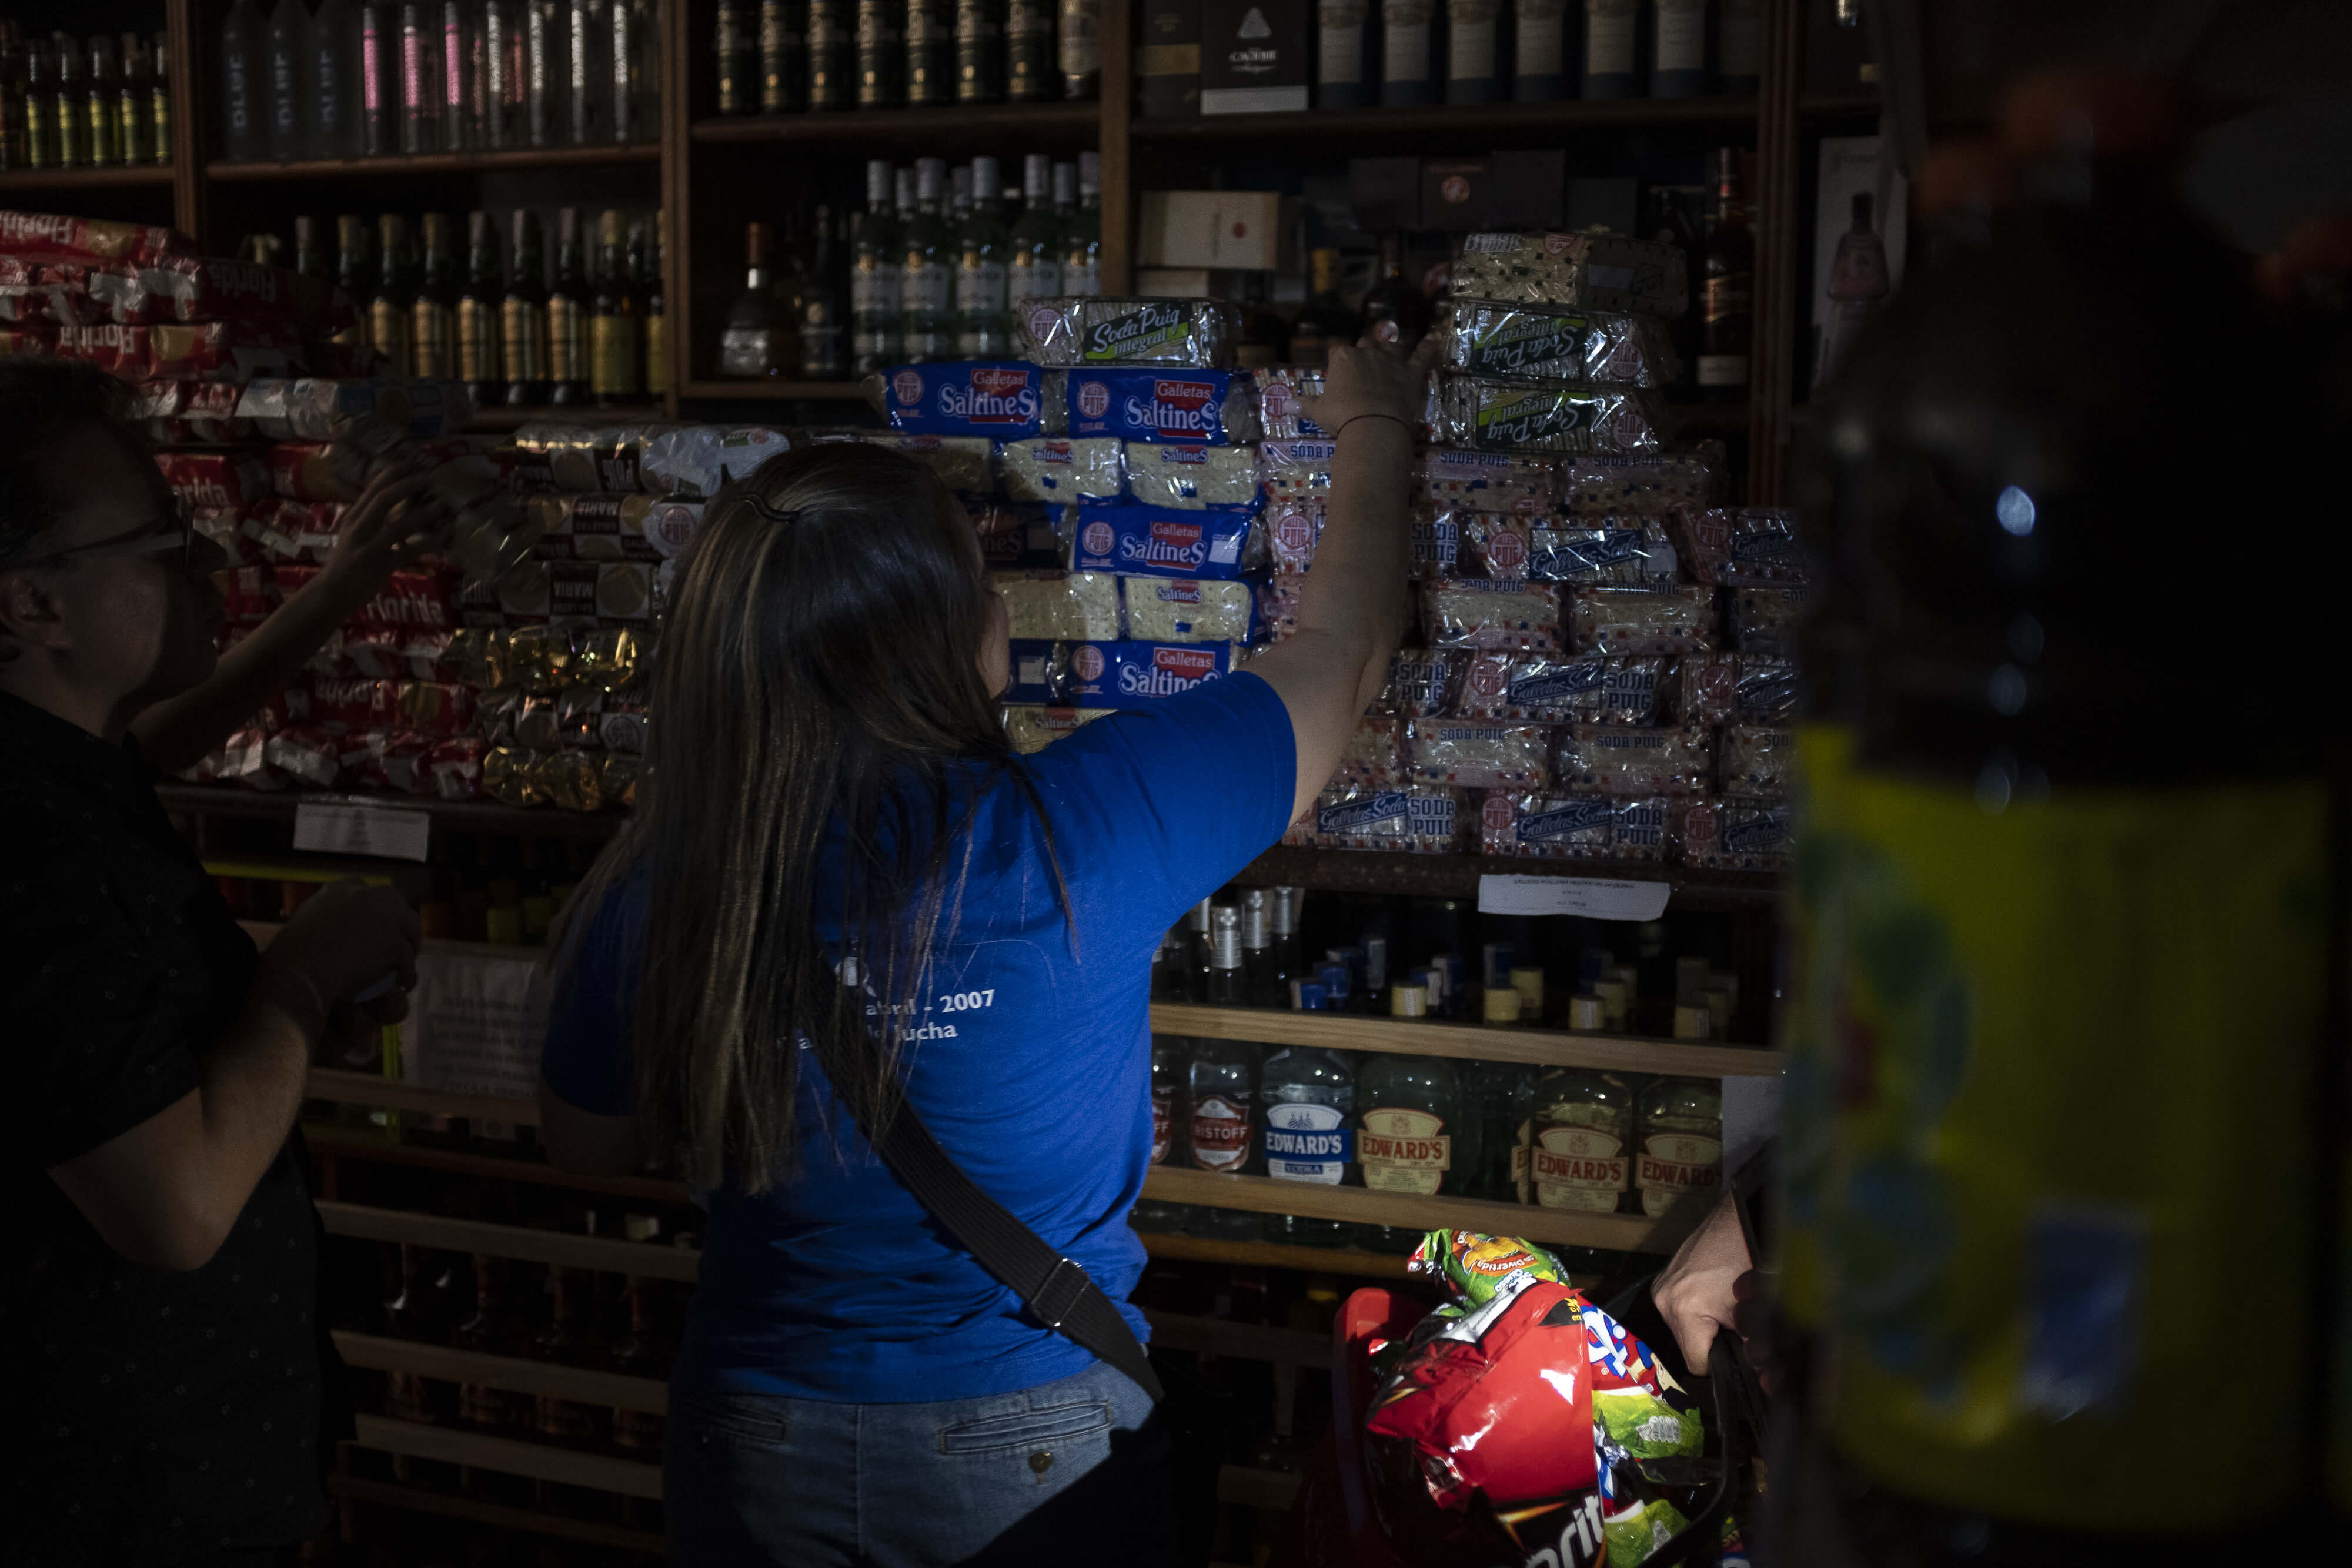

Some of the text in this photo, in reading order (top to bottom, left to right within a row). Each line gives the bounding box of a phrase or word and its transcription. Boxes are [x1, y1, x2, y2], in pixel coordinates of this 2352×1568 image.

[0, 211, 73, 245] Florid
[1093, 306, 1180, 353] Soda Puig
[1114, 331, 1167, 357] integral
[1482, 326, 1578, 367] Soda Puig
[973, 371, 1025, 385] Galletas
[1158, 382, 1211, 399] Galletas
[1487, 414, 1531, 442] Puig
[1291, 445, 1322, 457] SODA
[1441, 452, 1474, 464] SODA
[1153, 523, 1200, 537] Galletas
[1284, 529, 1307, 545] PUIG
[1412, 522, 1458, 540] SODA
[1415, 544, 1457, 561] PUIG
[1495, 546, 1518, 563] PUIG
[1157, 651, 1212, 668] Galletas
[1121, 664, 1219, 696] Saltin
[1400, 663, 1446, 680] SODA
[1606, 672, 1655, 690] SODA
[1401, 684, 1445, 701] PUIG
[1608, 693, 1653, 710] PUIG
[1440, 728, 1471, 740] SODA
[1596, 735, 1665, 748] SODA PUIG
[1372, 795, 1407, 818] Soda
[1411, 798, 1455, 815] SODA
[1616, 829, 1661, 845] PUIG
[939, 988, 996, 1013] 2007
[1266, 1131, 1342, 1155] EDWARD'S
[1362, 1136, 1444, 1161] EDWARD'S
[1537, 1157, 1622, 1182] EDWARD'S
